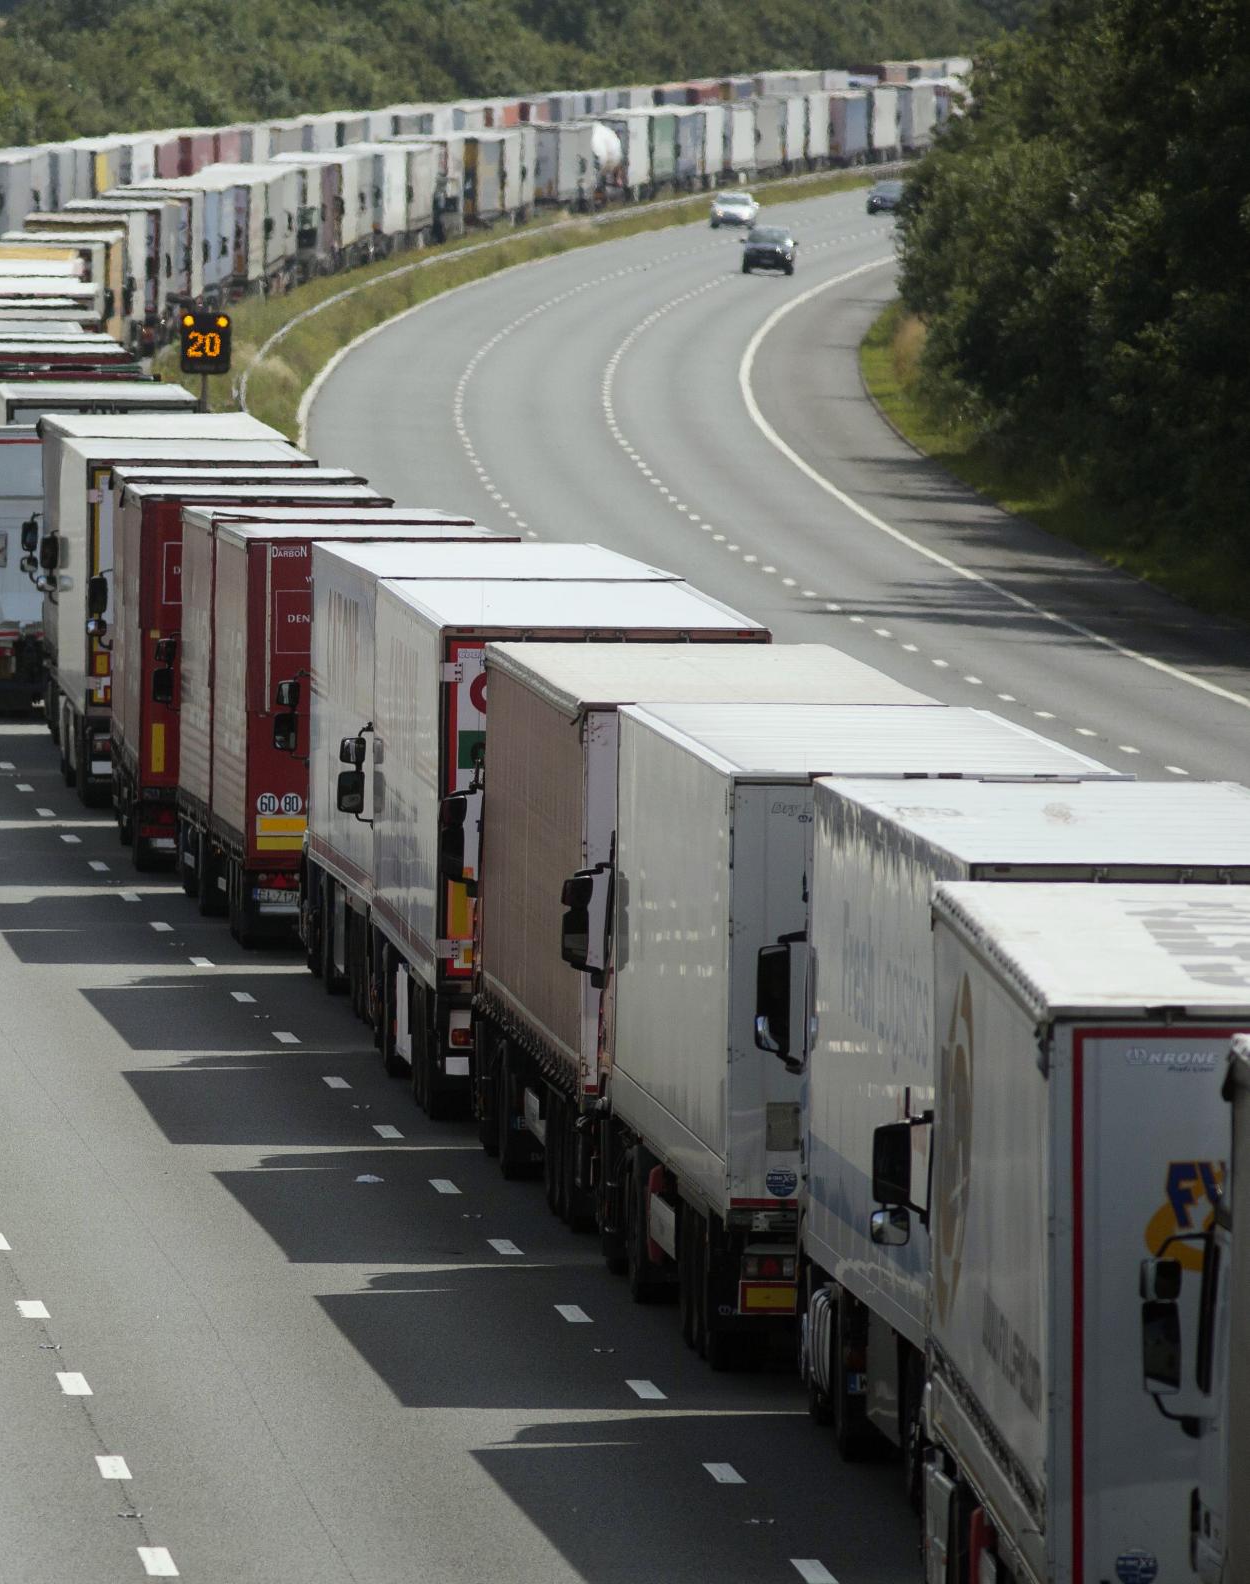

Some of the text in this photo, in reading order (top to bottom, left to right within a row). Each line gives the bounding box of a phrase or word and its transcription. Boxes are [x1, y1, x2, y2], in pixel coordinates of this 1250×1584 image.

[186, 331, 221, 358] 20
[260, 795, 276, 812] 60
[284, 795, 299, 812] 80
[1148, 1052, 1218, 1064] KRONE
